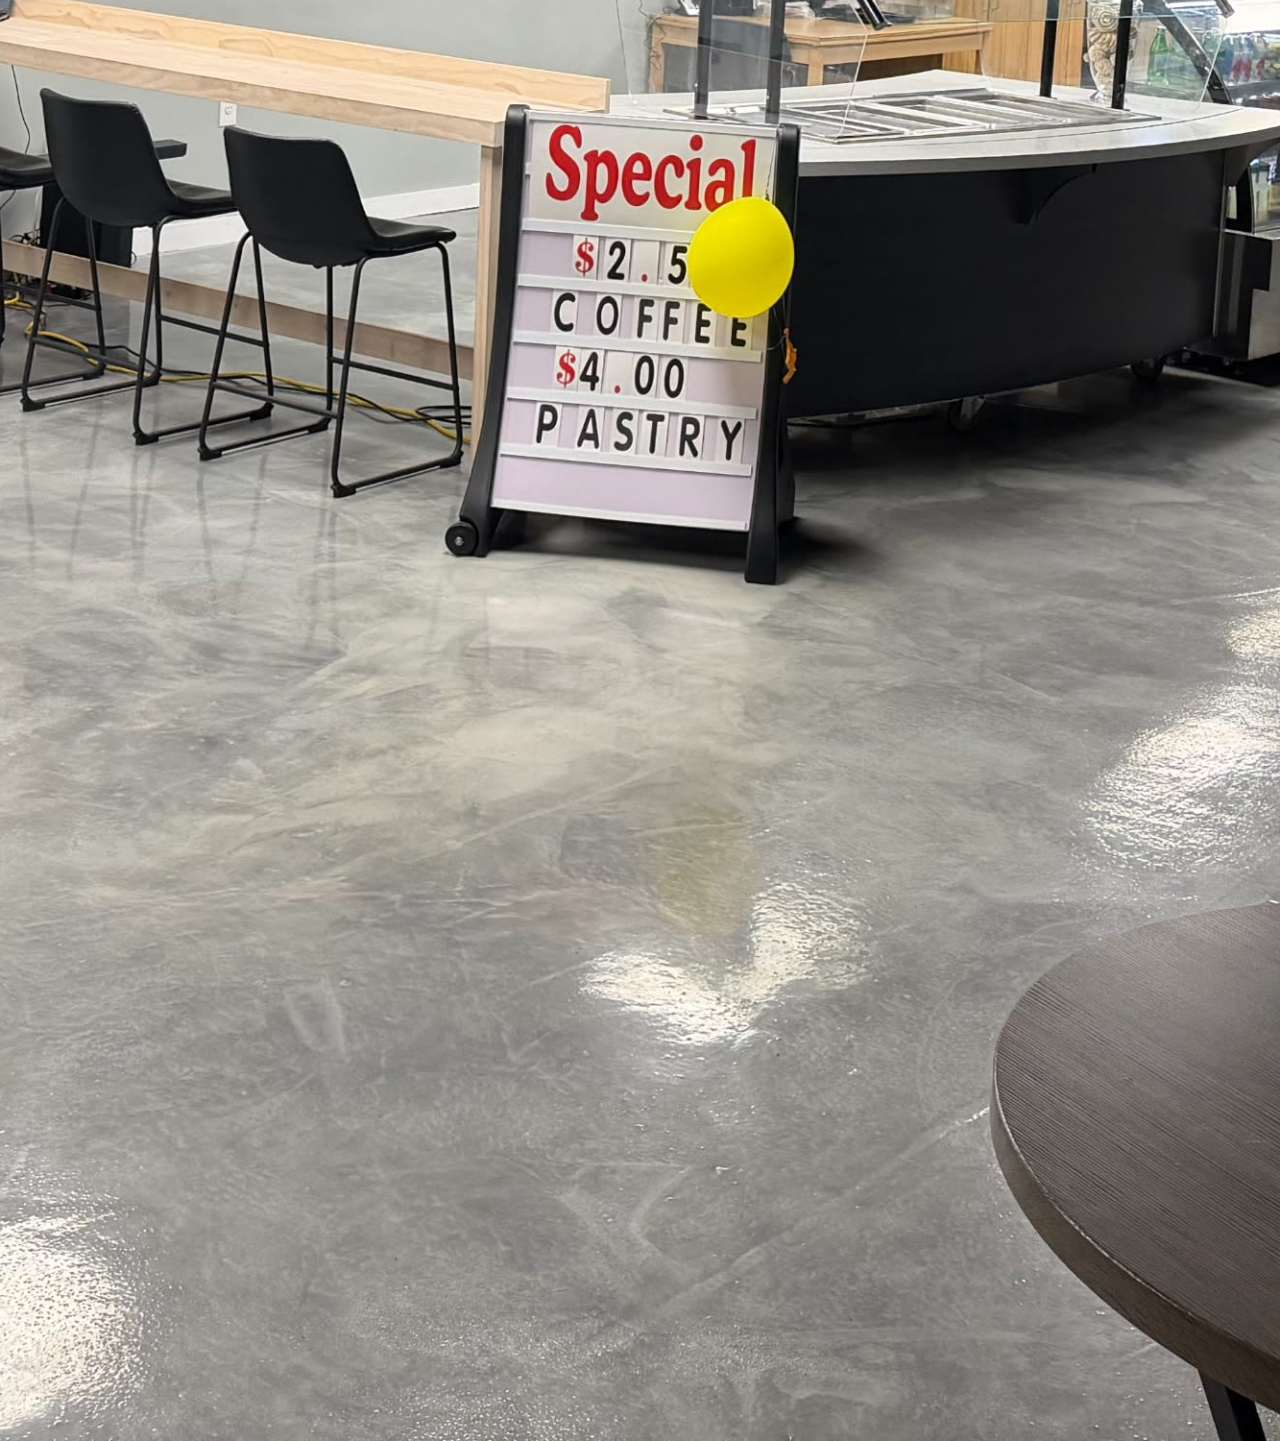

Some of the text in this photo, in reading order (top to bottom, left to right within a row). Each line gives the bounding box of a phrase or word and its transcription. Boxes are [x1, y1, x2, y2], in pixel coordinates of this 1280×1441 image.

[546, 124, 757, 221] Special
[575, 237, 688, 286] $2.5
[554, 292, 748, 347] COFFEE
[556, 350, 685, 399] $4.00
[536, 403, 742, 462] PASTRY
